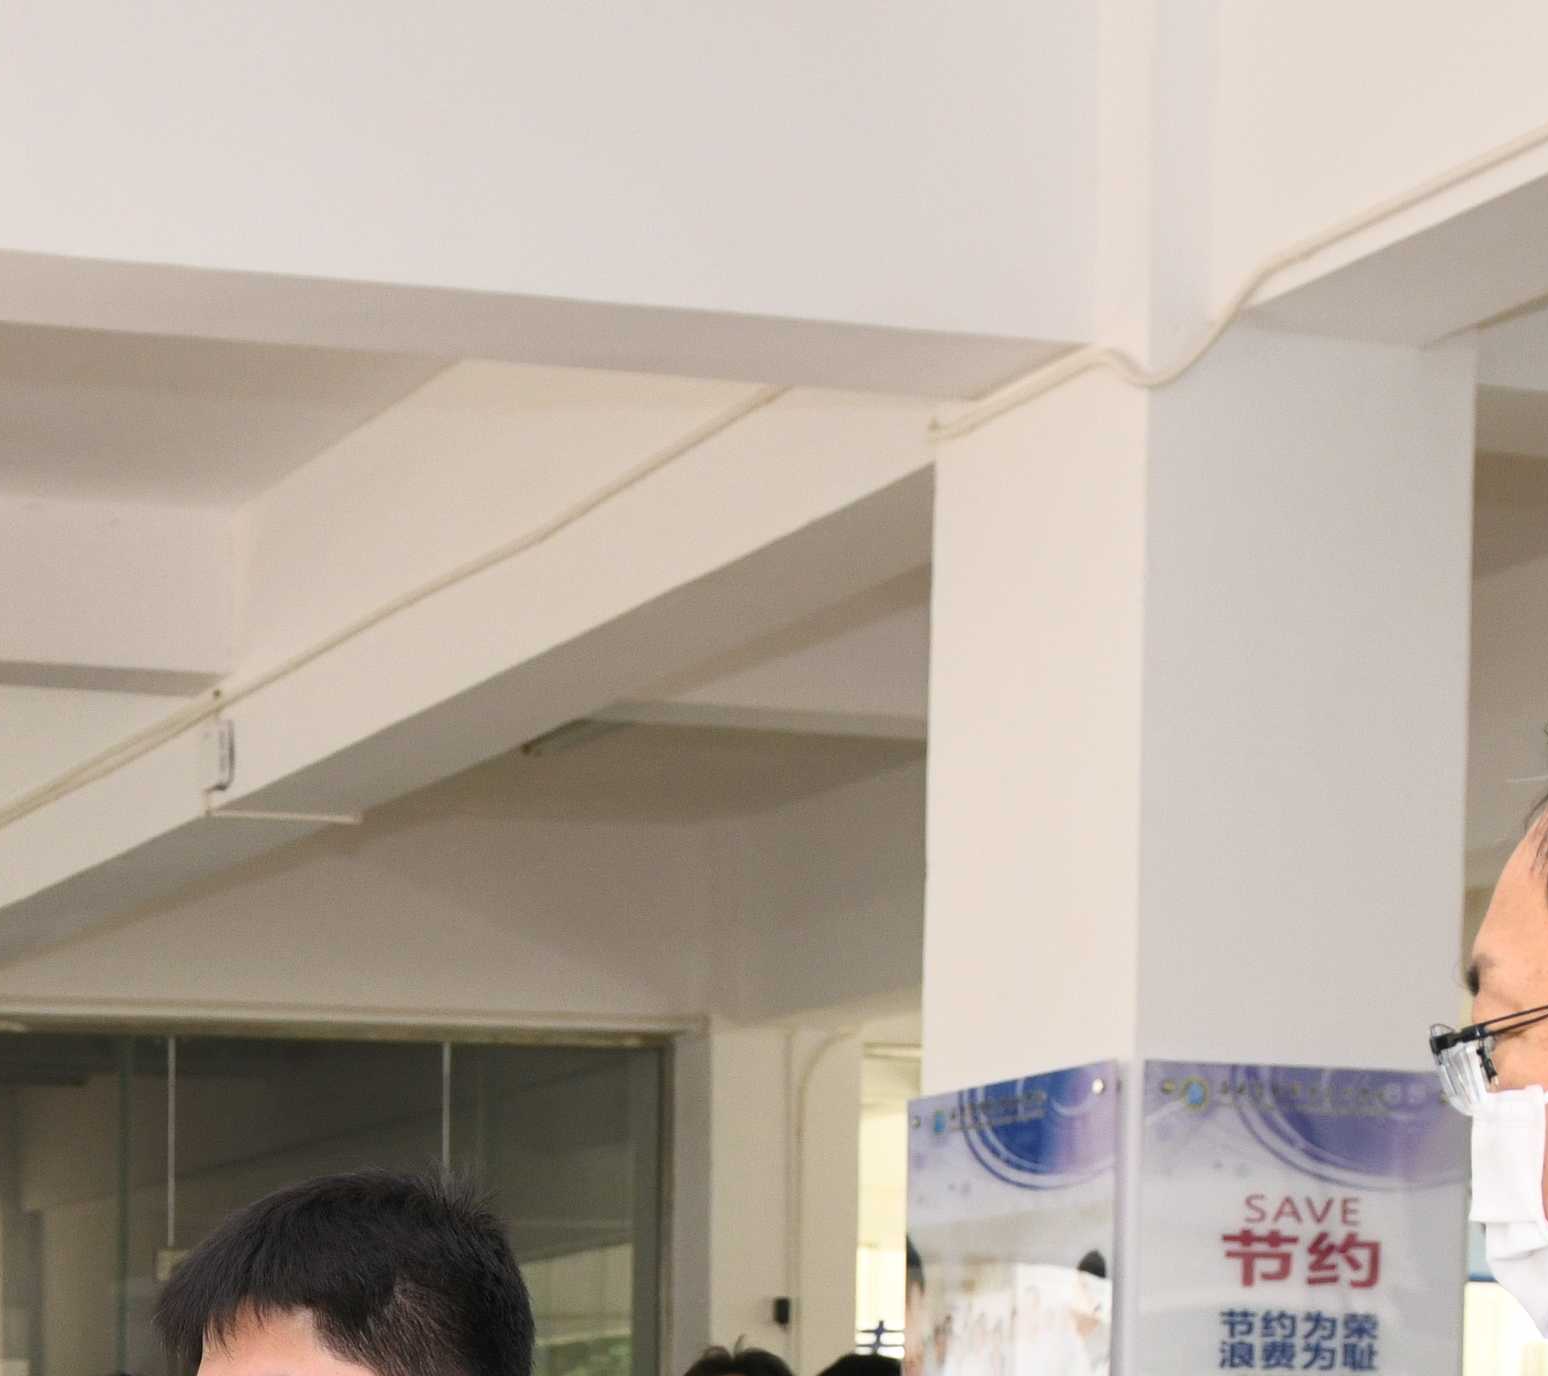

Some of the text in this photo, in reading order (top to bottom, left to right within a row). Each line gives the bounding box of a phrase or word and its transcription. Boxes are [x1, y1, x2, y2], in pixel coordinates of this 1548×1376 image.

[1244, 1194, 1361, 1226] SAVE
[1221, 1228, 1382, 1289] 节约
[1219, 1308, 1380, 1340] 节约为荣
[1218, 1340, 1378, 1372] 浪费为耻
